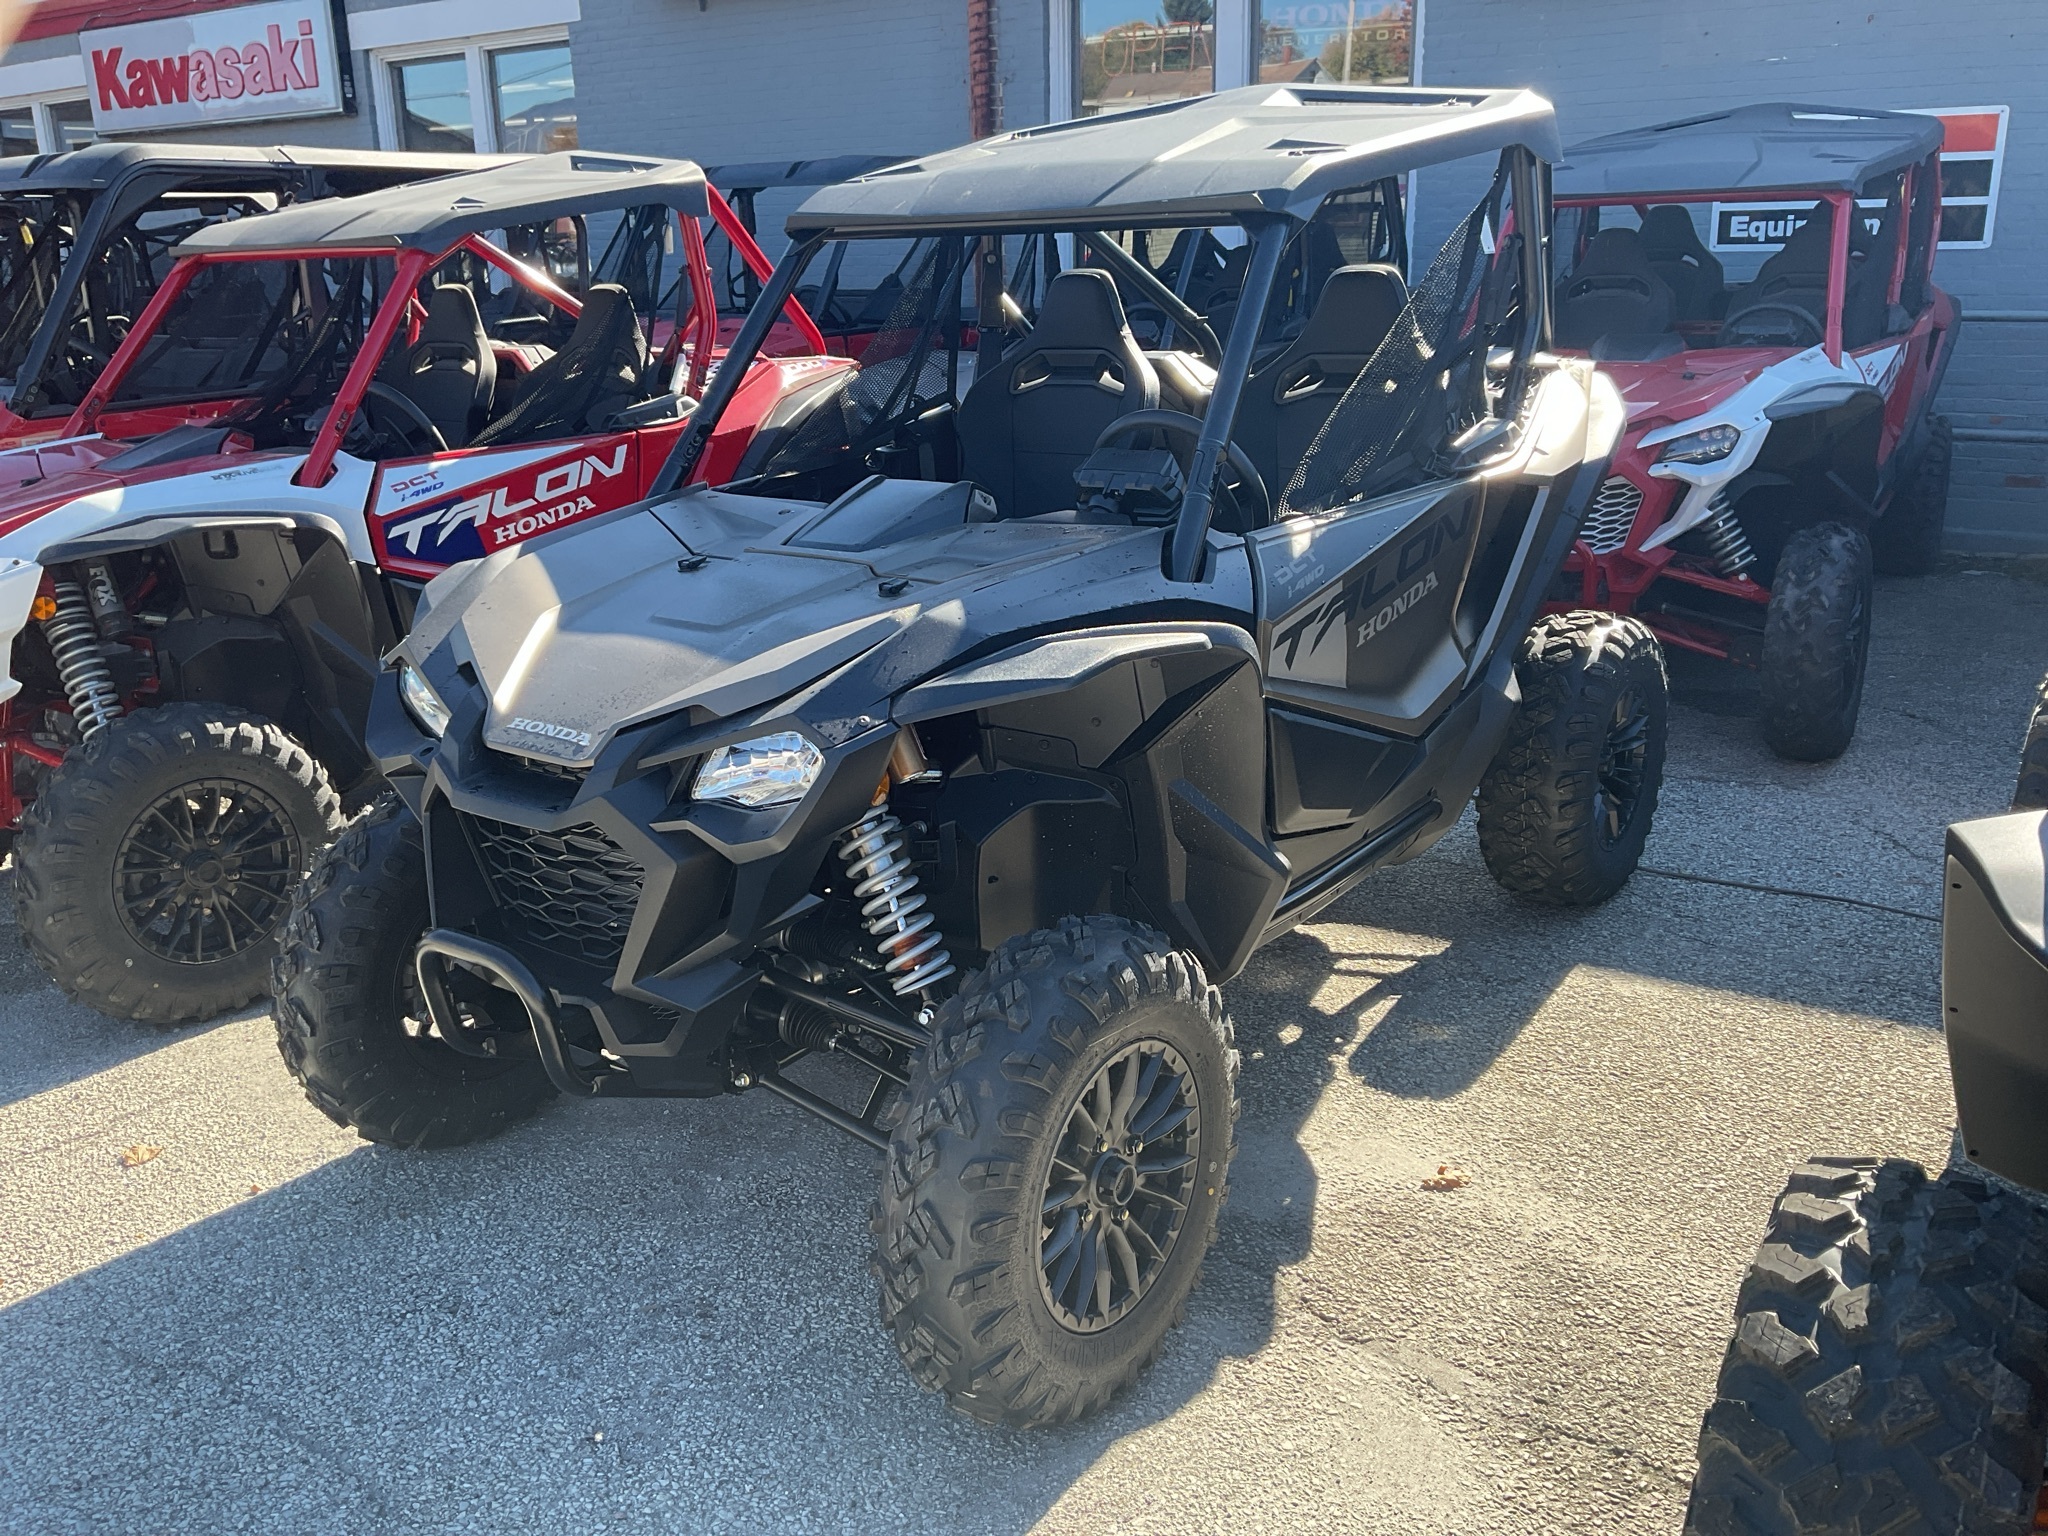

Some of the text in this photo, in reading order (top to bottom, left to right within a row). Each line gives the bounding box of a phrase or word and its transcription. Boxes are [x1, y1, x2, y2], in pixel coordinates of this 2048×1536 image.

[91, 19, 319, 111] Kawasaki
[1102, 21, 1213, 77] OPEN
[387, 444, 628, 555] TALON
[391, 470, 439, 493] DCT
[494, 496, 596, 544] HONDA
[88, 565, 117, 607] FOX
[1273, 548, 1317, 585] DCT
[1273, 494, 1475, 671] TALON
[1356, 571, 1439, 648] HONDA
[506, 717, 592, 746] HONDA
